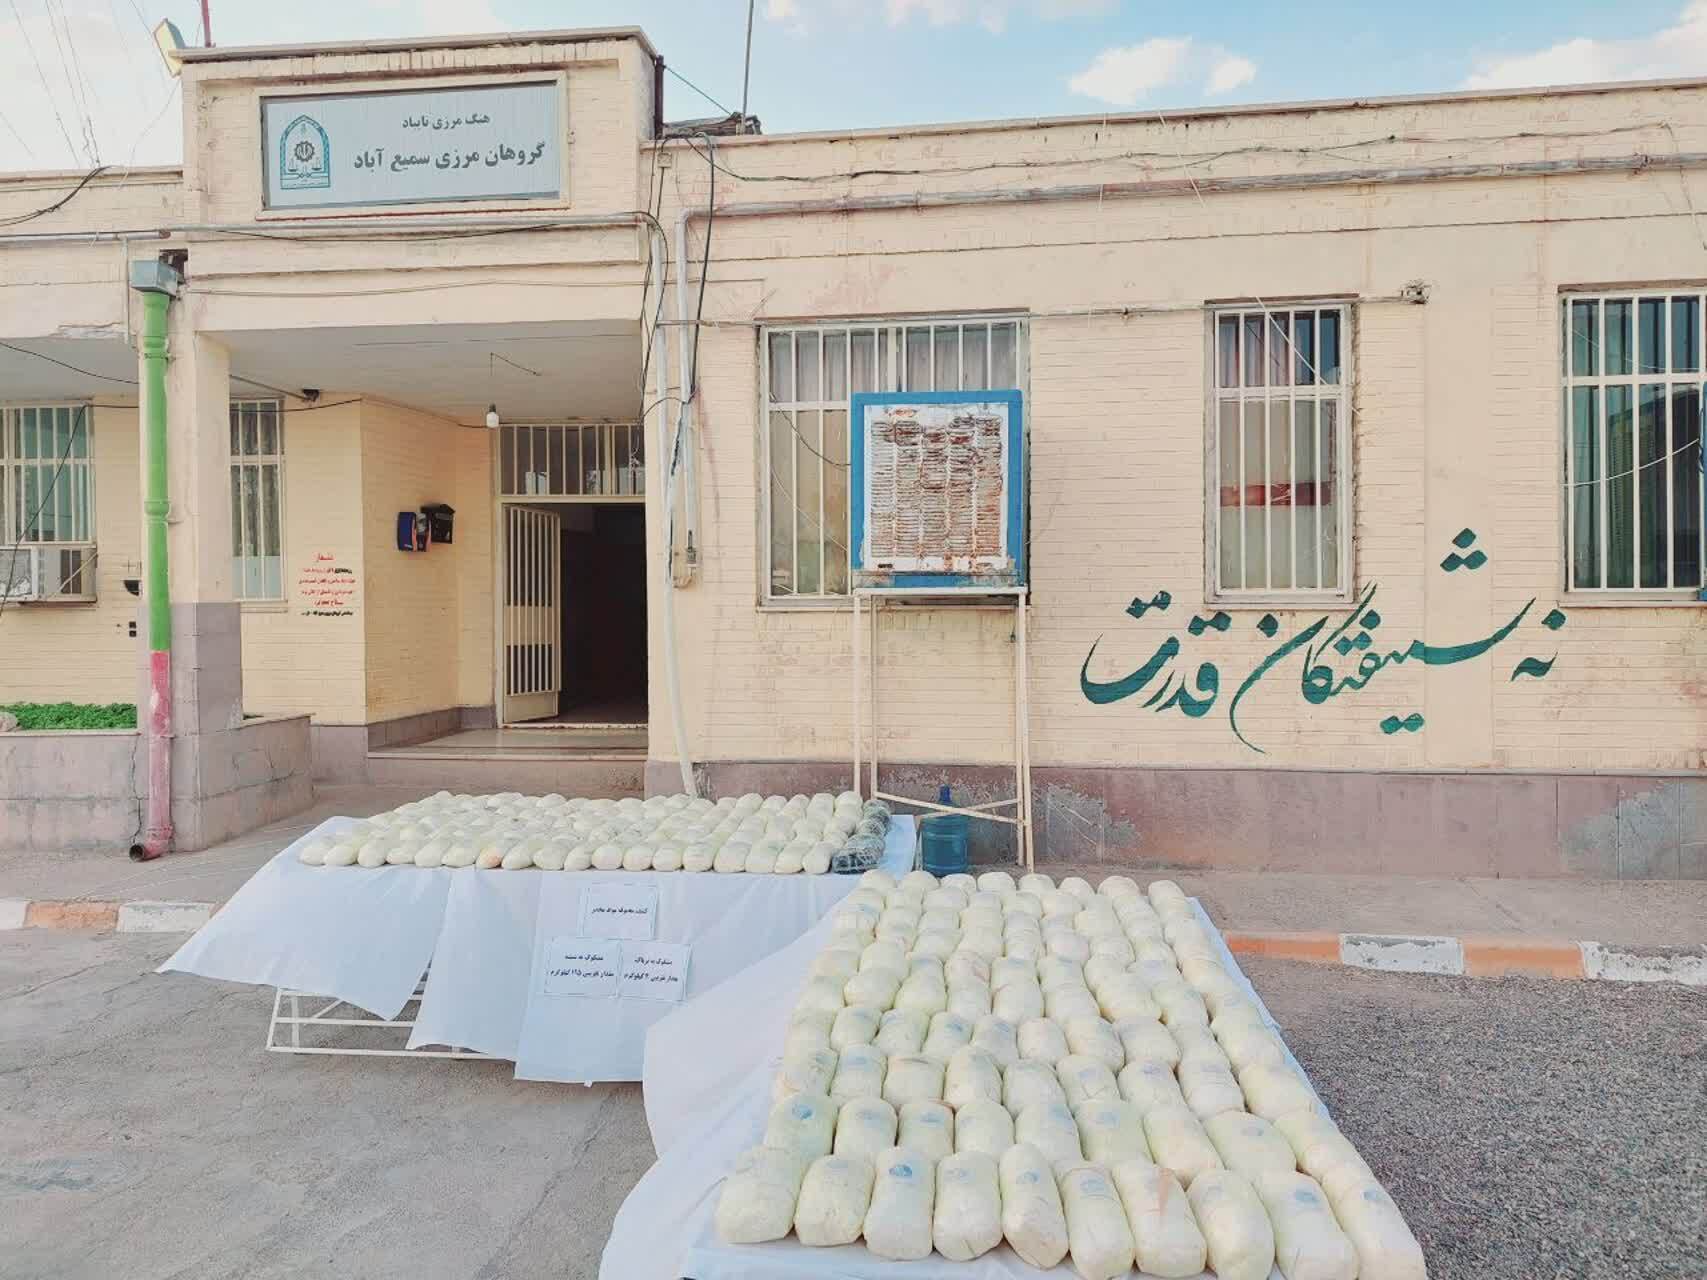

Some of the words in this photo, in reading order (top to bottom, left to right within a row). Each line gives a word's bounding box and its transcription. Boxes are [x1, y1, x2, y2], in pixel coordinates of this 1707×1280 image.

[431, 116, 463, 131] مرزی
[464, 112, 491, 126] هنگ
[353, 147, 385, 173] آباد
[390, 151, 431, 172] سمیع
[434, 149, 480, 170] مرزی
[483, 140, 546, 169] گروهان
[1080, 590, 1232, 718] قدرت
[1229, 527, 1537, 756] شیفتگان
[1511, 609, 1567, 682] نه
